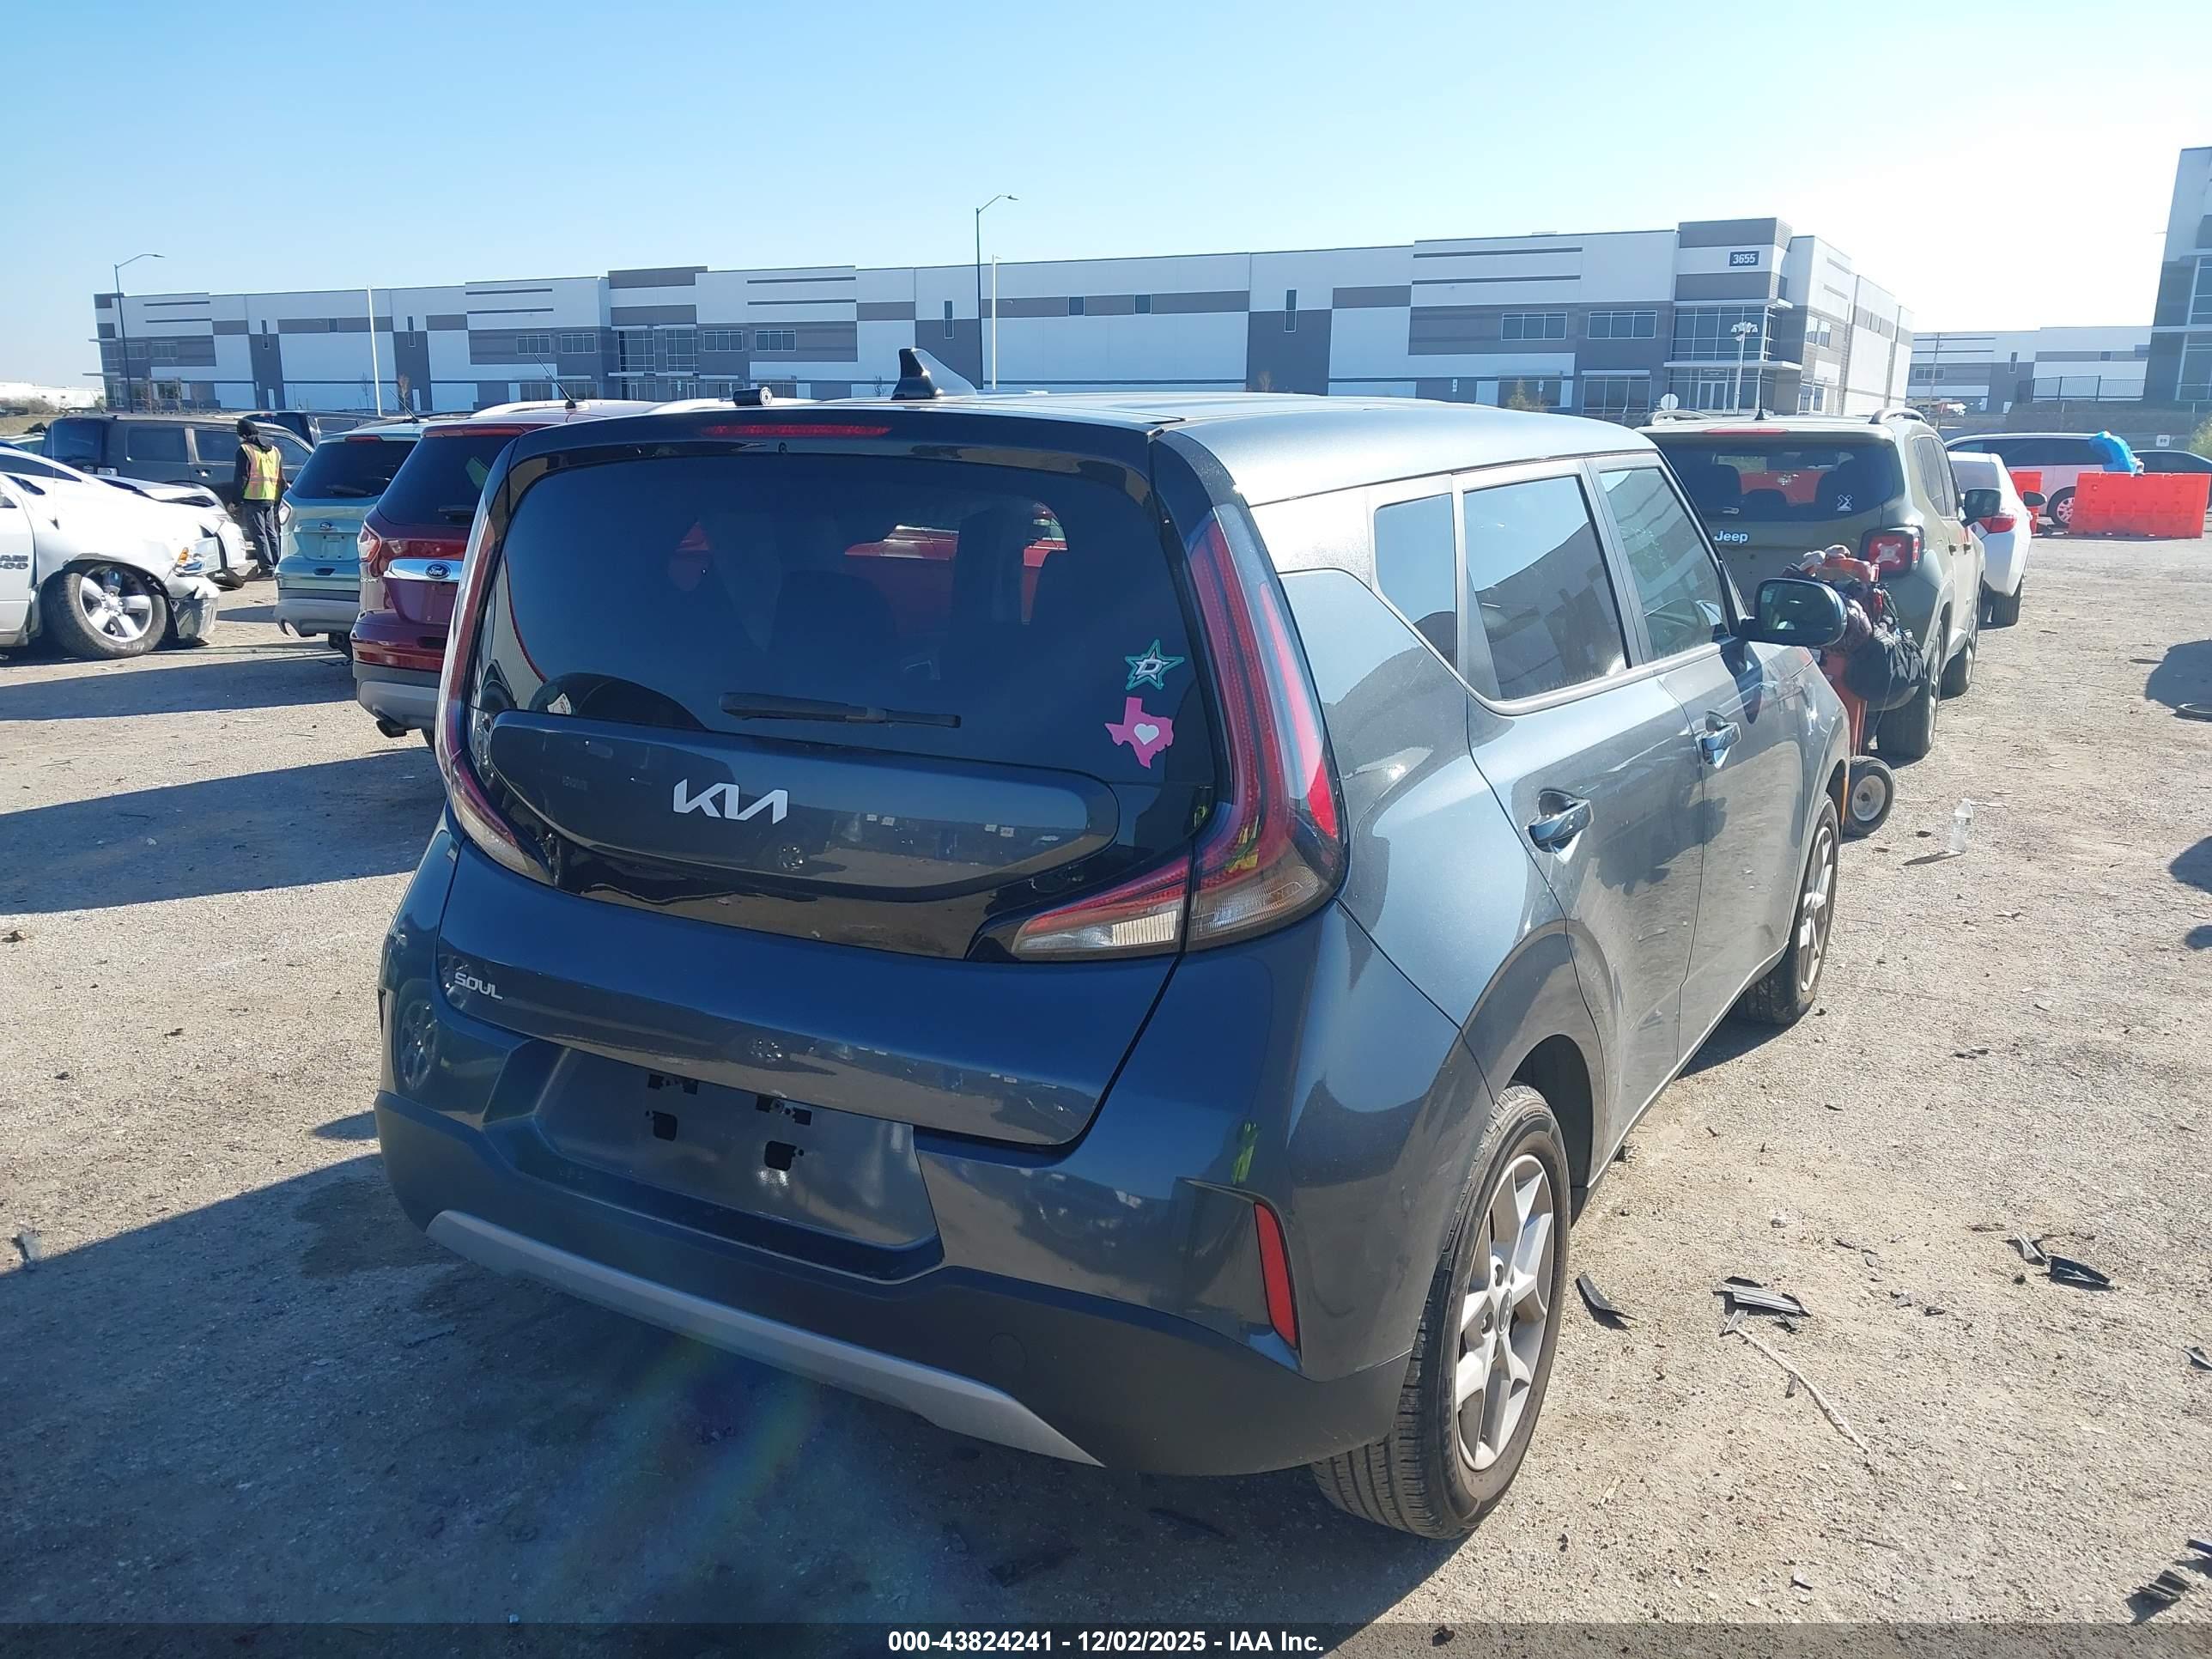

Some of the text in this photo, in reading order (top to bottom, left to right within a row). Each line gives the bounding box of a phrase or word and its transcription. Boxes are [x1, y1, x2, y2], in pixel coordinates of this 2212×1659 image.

[1733, 253, 1756, 264] 3655
[1714, 531, 1748, 544] Jeep
[673, 779, 788, 824] KIA
[453, 972, 503, 1000] SOUL
